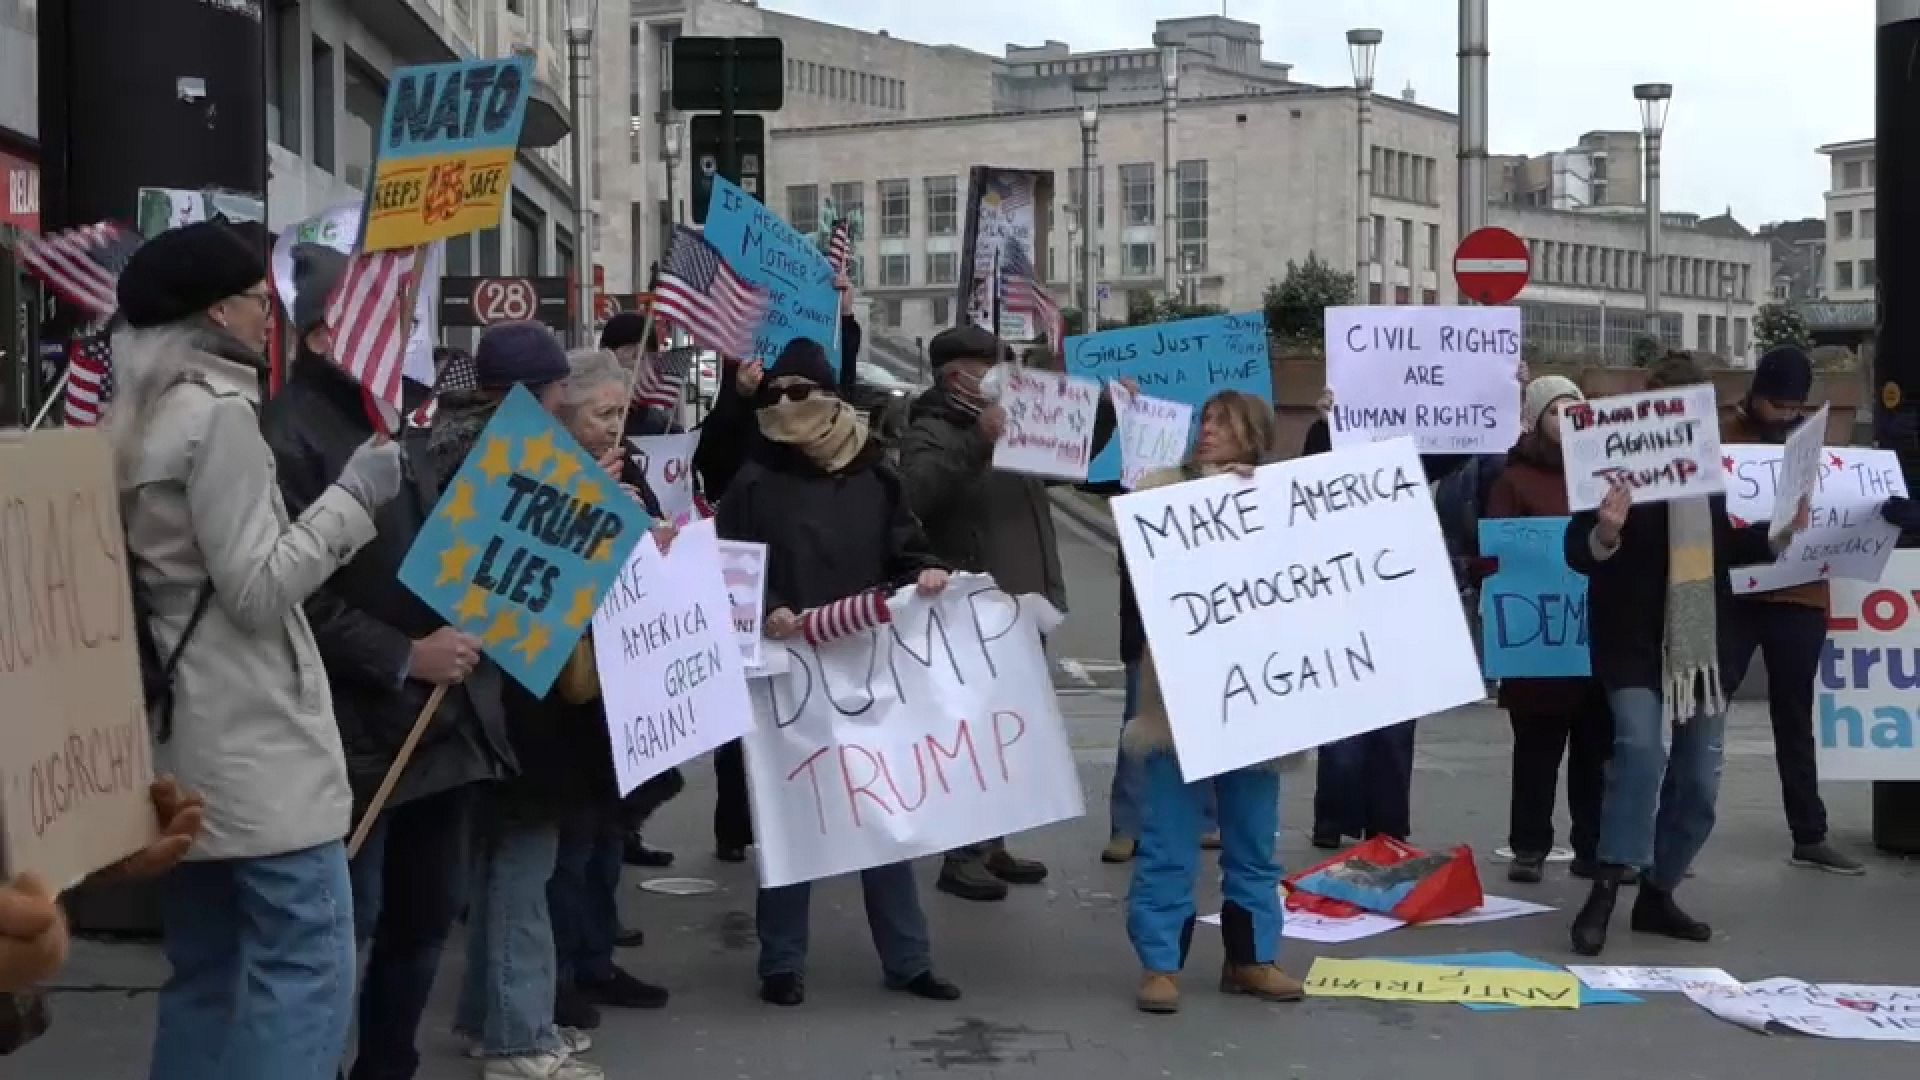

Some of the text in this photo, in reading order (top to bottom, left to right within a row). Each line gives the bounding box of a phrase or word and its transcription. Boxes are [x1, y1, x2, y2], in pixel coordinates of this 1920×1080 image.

[390, 64, 522, 148] NATO
[466, 169, 503, 199] SAFE
[721, 188, 743, 212] IF
[487, 283, 527, 318] 28
[1151, 331, 1210, 356] JUST
[1346, 323, 1520, 355] CIVIL RIGHTS
[1207, 359, 1260, 385] HAVE
[1403, 364, 1445, 386] ARE
[1333, 403, 1498, 433] HUMAN RIGHTS
[1605, 420, 1700, 459] AGAINST
[1737, 457, 1831, 500] STP
[1849, 462, 1901, 497] THE
[501, 471, 625, 560] TRUMP
[1133, 466, 1421, 559] MAKE AMERICA
[1809, 505, 1857, 529] EAL
[471, 535, 561, 612] LIES
[1169, 548, 1417, 636] DEMOCRATIC
[1824, 579, 1920, 633] Lo
[621, 602, 709, 665] AMERICA
[768, 587, 1020, 729] DUMP
[663, 642, 723, 698] GREEN
[1222, 630, 1376, 725] AGAIN
[624, 696, 698, 772] AGAIN!
[1818, 693, 1920, 749] ha
[786, 710, 1026, 836] TRUMP
[1463, 984, 1572, 1001] ANTI
